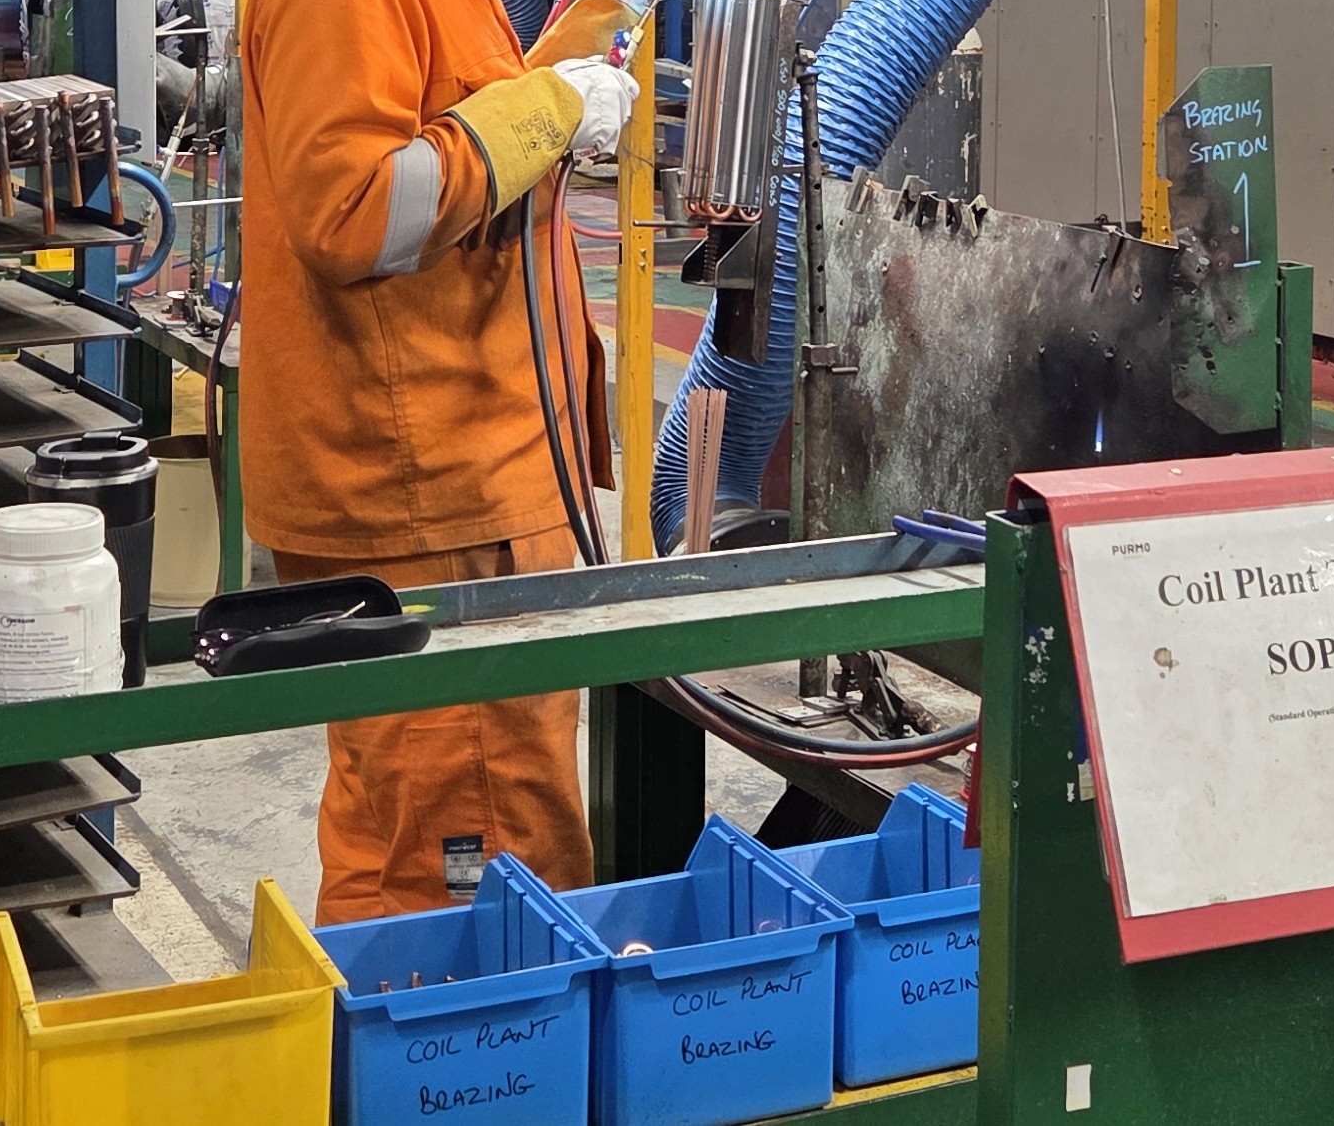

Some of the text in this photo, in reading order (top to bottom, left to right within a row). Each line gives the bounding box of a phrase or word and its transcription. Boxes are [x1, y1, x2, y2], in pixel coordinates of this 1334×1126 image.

[1182, 99, 1262, 129] BRAZING
[1189, 135, 1269, 164] STATION
[1233, 172, 1262, 268] 1
[1111, 542, 1151, 556] PURMO
[1158, 571, 1227, 607] Coil
[1234, 564, 1319, 600] Plant
[1268, 710, 1306, 723] (Standard
[889, 931, 980, 962] COIL PLA
[673, 970, 813, 1016] COIL PLANT
[406, 1014, 560, 1064] COIL PLANT
[681, 1029, 777, 1065] BRAZING
[419, 1071, 536, 1116] BRAZING
